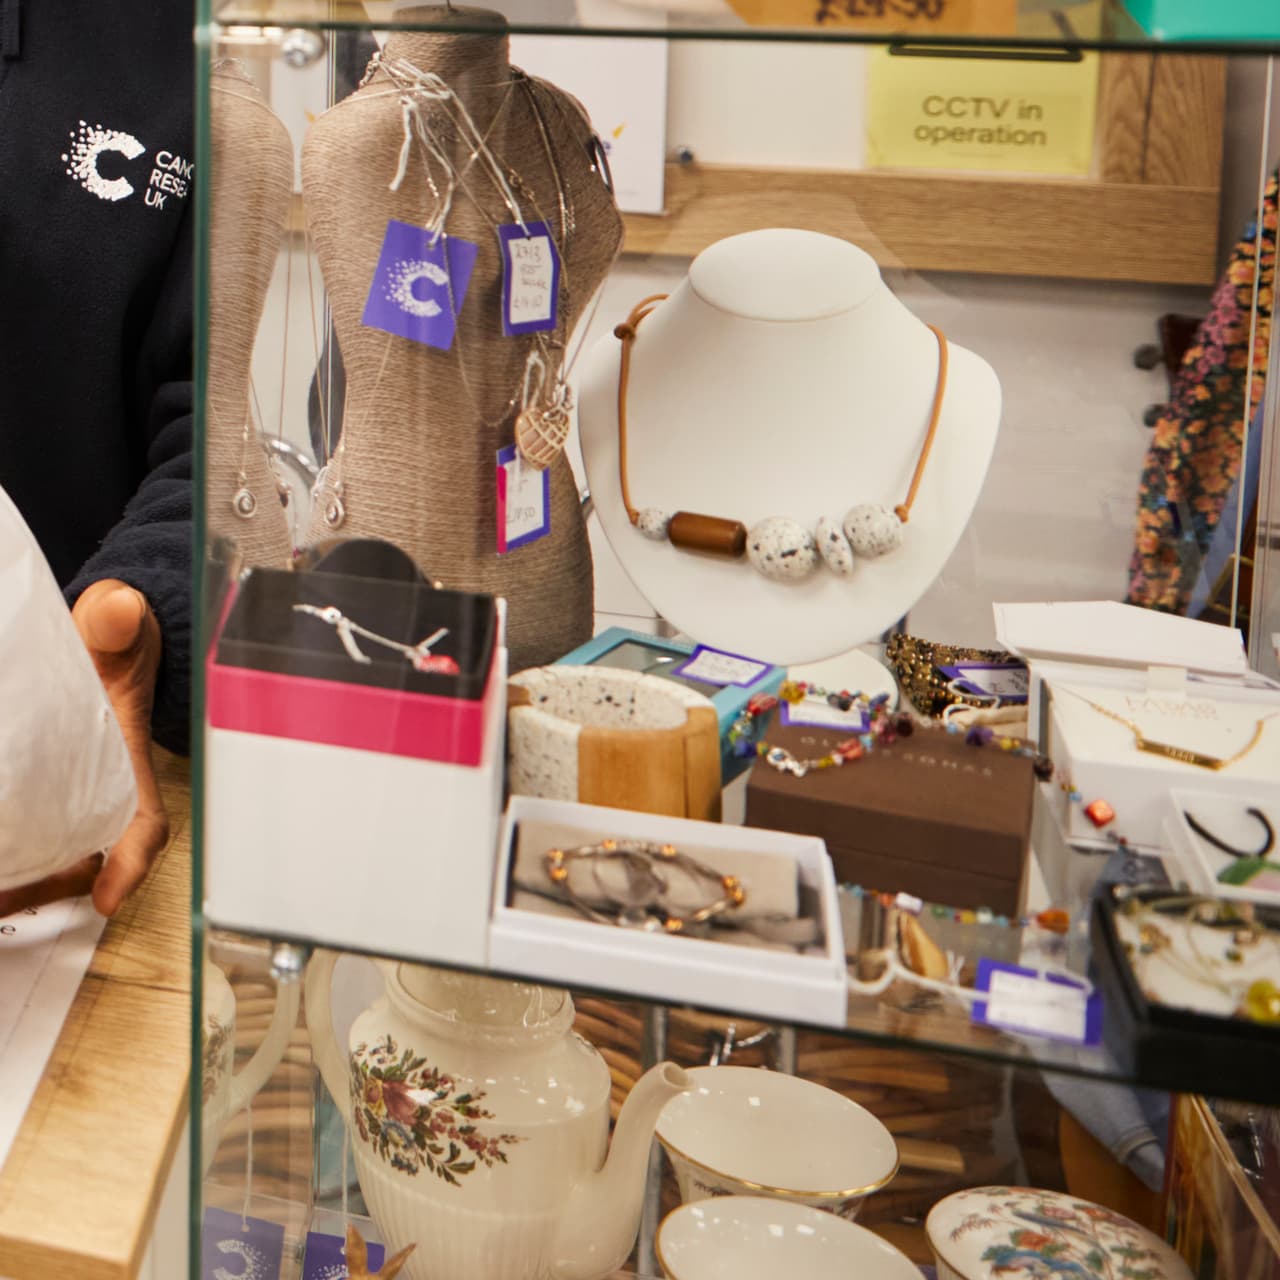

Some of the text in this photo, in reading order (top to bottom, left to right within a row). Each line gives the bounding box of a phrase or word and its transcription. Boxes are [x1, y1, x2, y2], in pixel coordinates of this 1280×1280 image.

[921, 94, 1044, 121] CCTV in
[913, 124, 1049, 147] operation
[143, 187, 169, 211] UK
